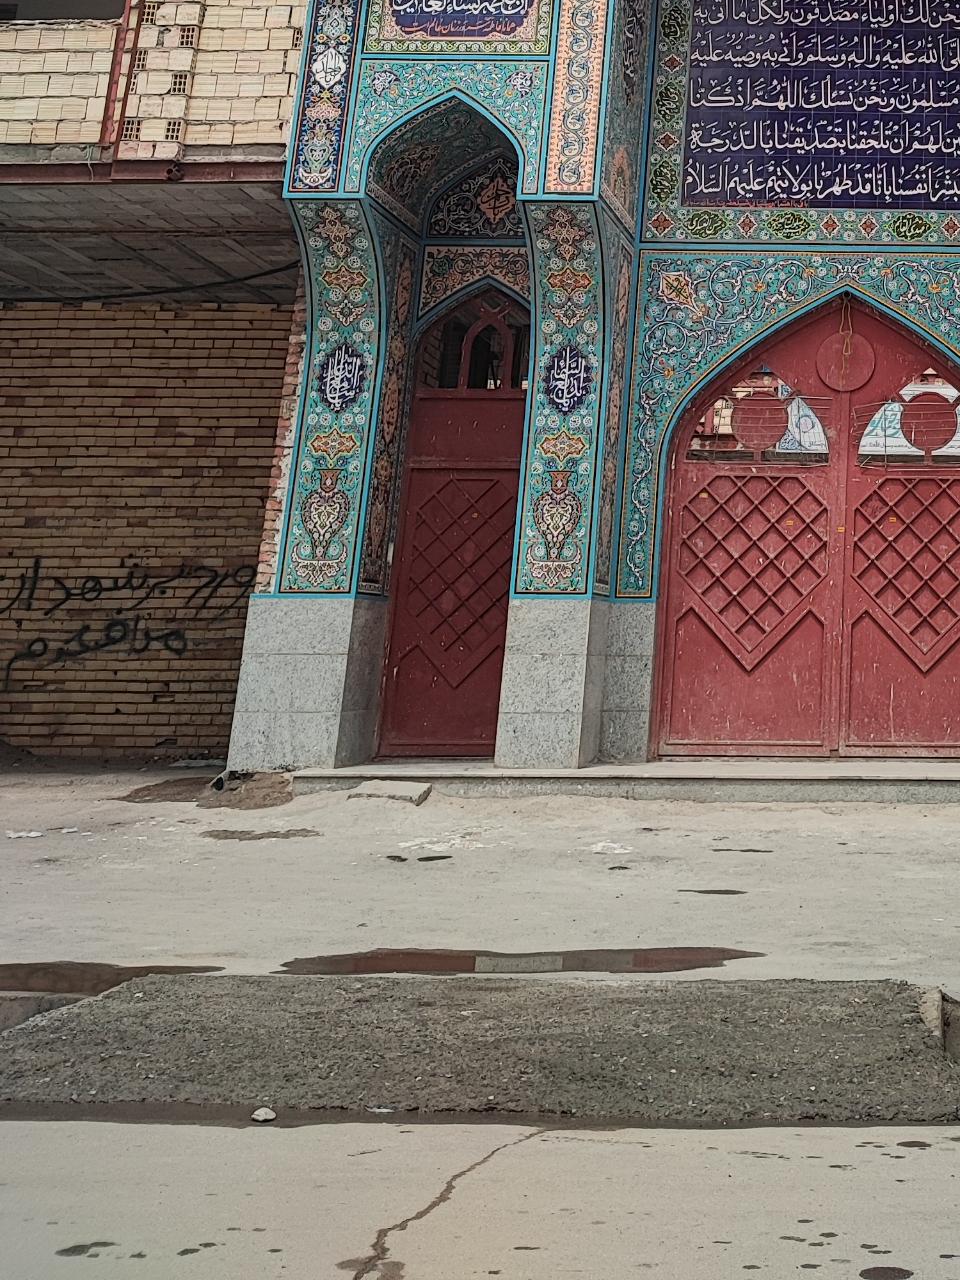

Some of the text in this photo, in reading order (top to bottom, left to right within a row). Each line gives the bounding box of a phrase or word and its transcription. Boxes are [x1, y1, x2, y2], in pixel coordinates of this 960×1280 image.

[693, 0, 709, 26] به
[689, 31, 726, 67] عليه
[761, 42, 779, 67] به
[882, 35, 918, 69] عليه
[917, 34, 944, 65] الله
[743, 77, 803, 111] اللهم
[853, 80, 897, 112] ونحن
[896, 78, 960, 114] مسلمون
[774, 119, 847, 156] بتصديقنا
[889, 120, 910, 154] ان
[906, 120, 943, 154] لهم
[684, 159, 729, 199] السلام
[848, 166, 873, 196] قد
